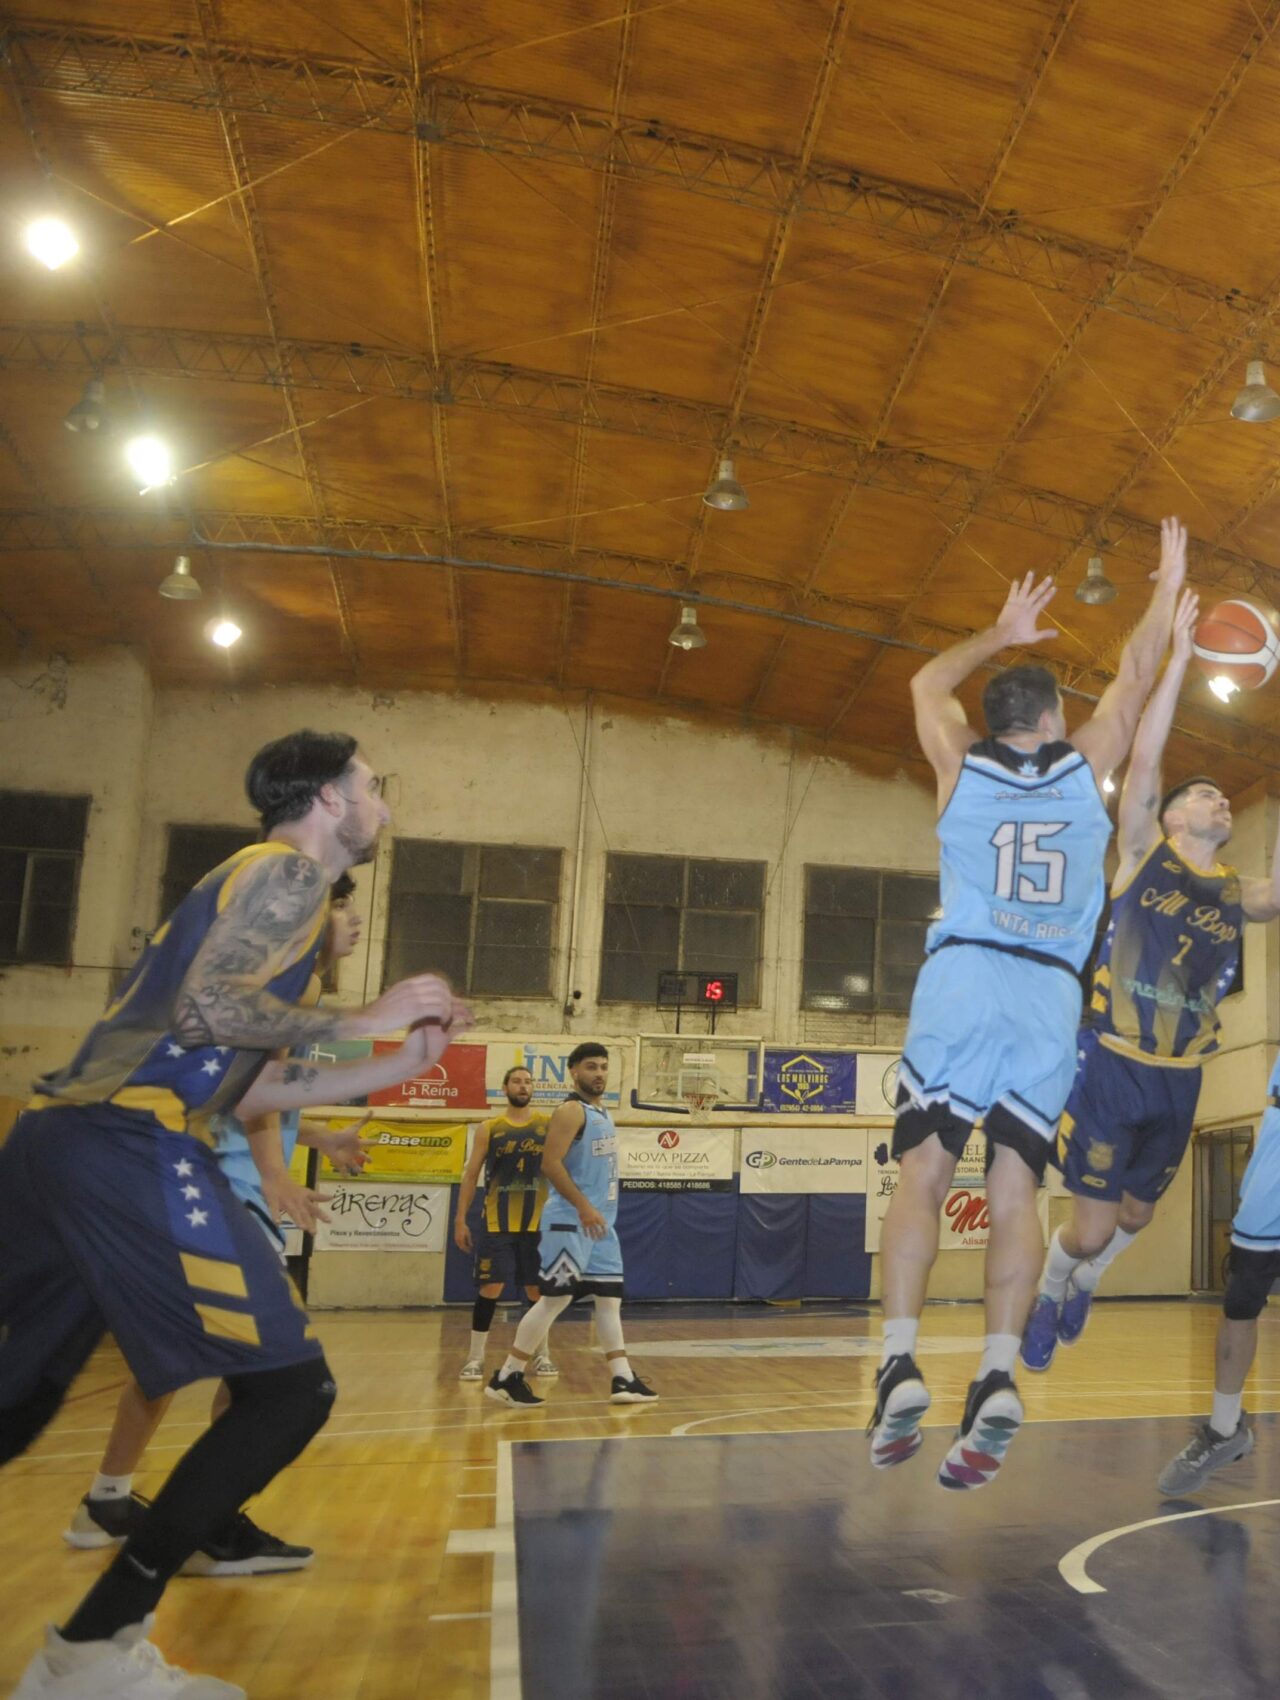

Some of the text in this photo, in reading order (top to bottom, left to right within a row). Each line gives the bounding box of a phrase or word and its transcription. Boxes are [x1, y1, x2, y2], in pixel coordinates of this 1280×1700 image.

[989, 821, 1072, 905] 15
[1140, 887, 1190, 917] All
[1171, 933, 1194, 966] 7
[402, 1084, 458, 1097] La Reina
[378, 1132, 452, 1148] Baseuno
[627, 1152, 710, 1163] NOVA PIZZA
[622, 1181, 656, 1190] PEDIDOS:
